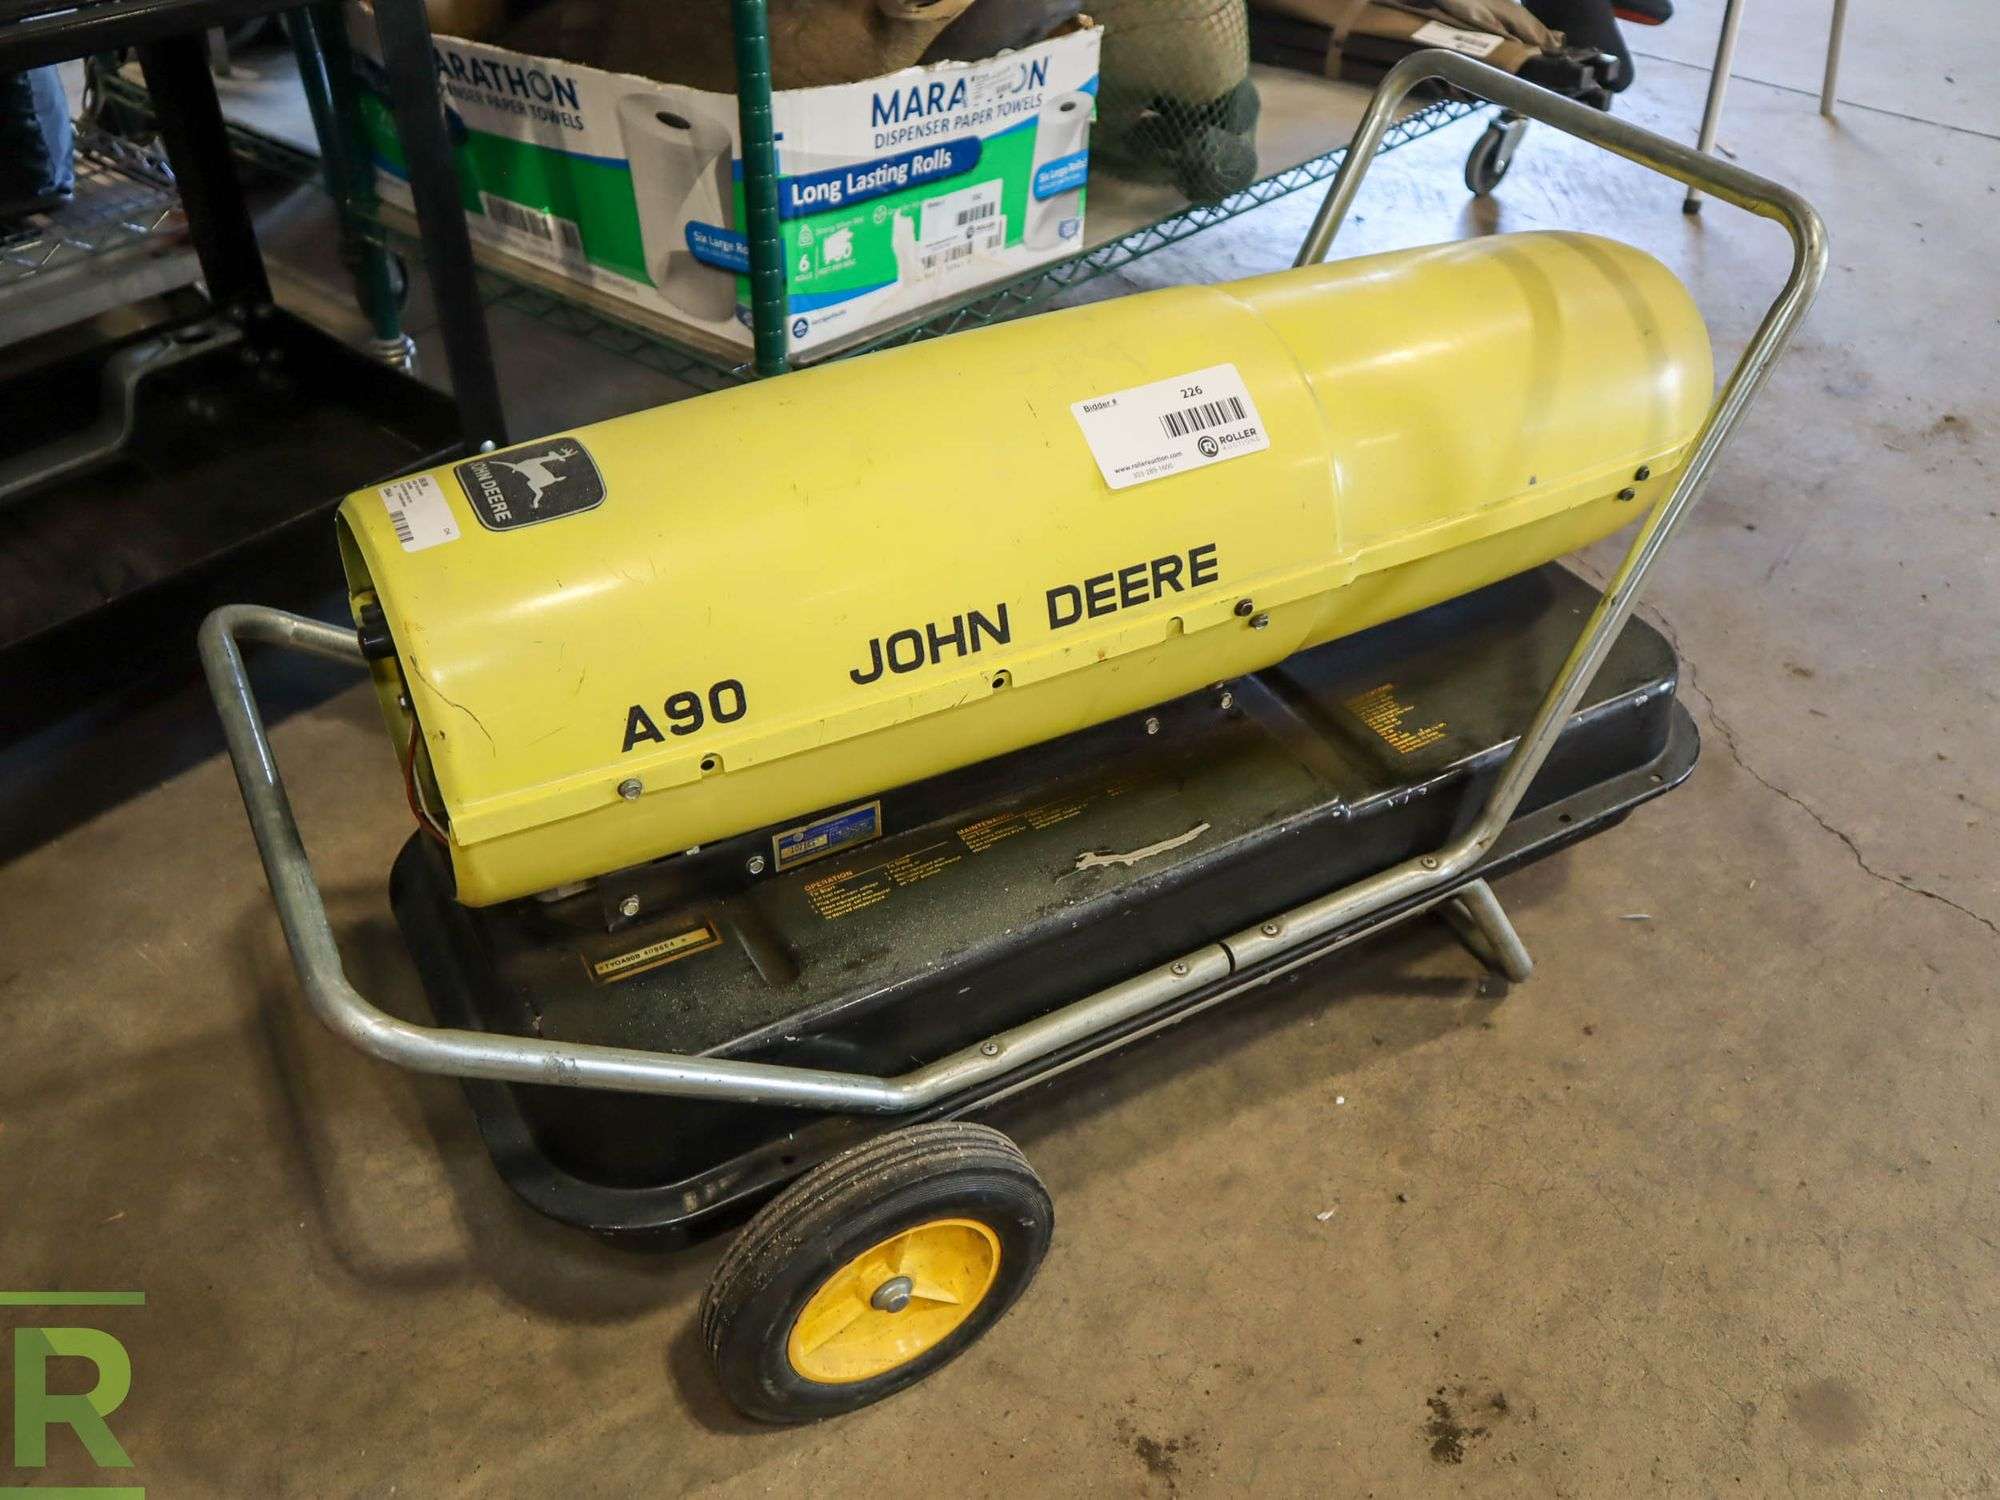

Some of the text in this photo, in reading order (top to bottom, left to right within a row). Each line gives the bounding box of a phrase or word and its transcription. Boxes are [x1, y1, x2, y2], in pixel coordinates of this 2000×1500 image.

[434, 48, 579, 111] ARATHON
[874, 93, 1043, 149] DISPENSER PAPER TOWELS
[791, 149, 952, 205] Long Lasting Rolls
[798, 255, 810, 271] 6
[1083, 401, 1111, 413] Bidder
[1180, 385, 1203, 399] 226
[1219, 427, 1257, 444] ROLLER
[481, 480, 512, 522] DEERE
[850, 543, 1219, 685] JOHN DEERE
[621, 678, 748, 753] A90
[803, 869, 854, 891] OPERATION
